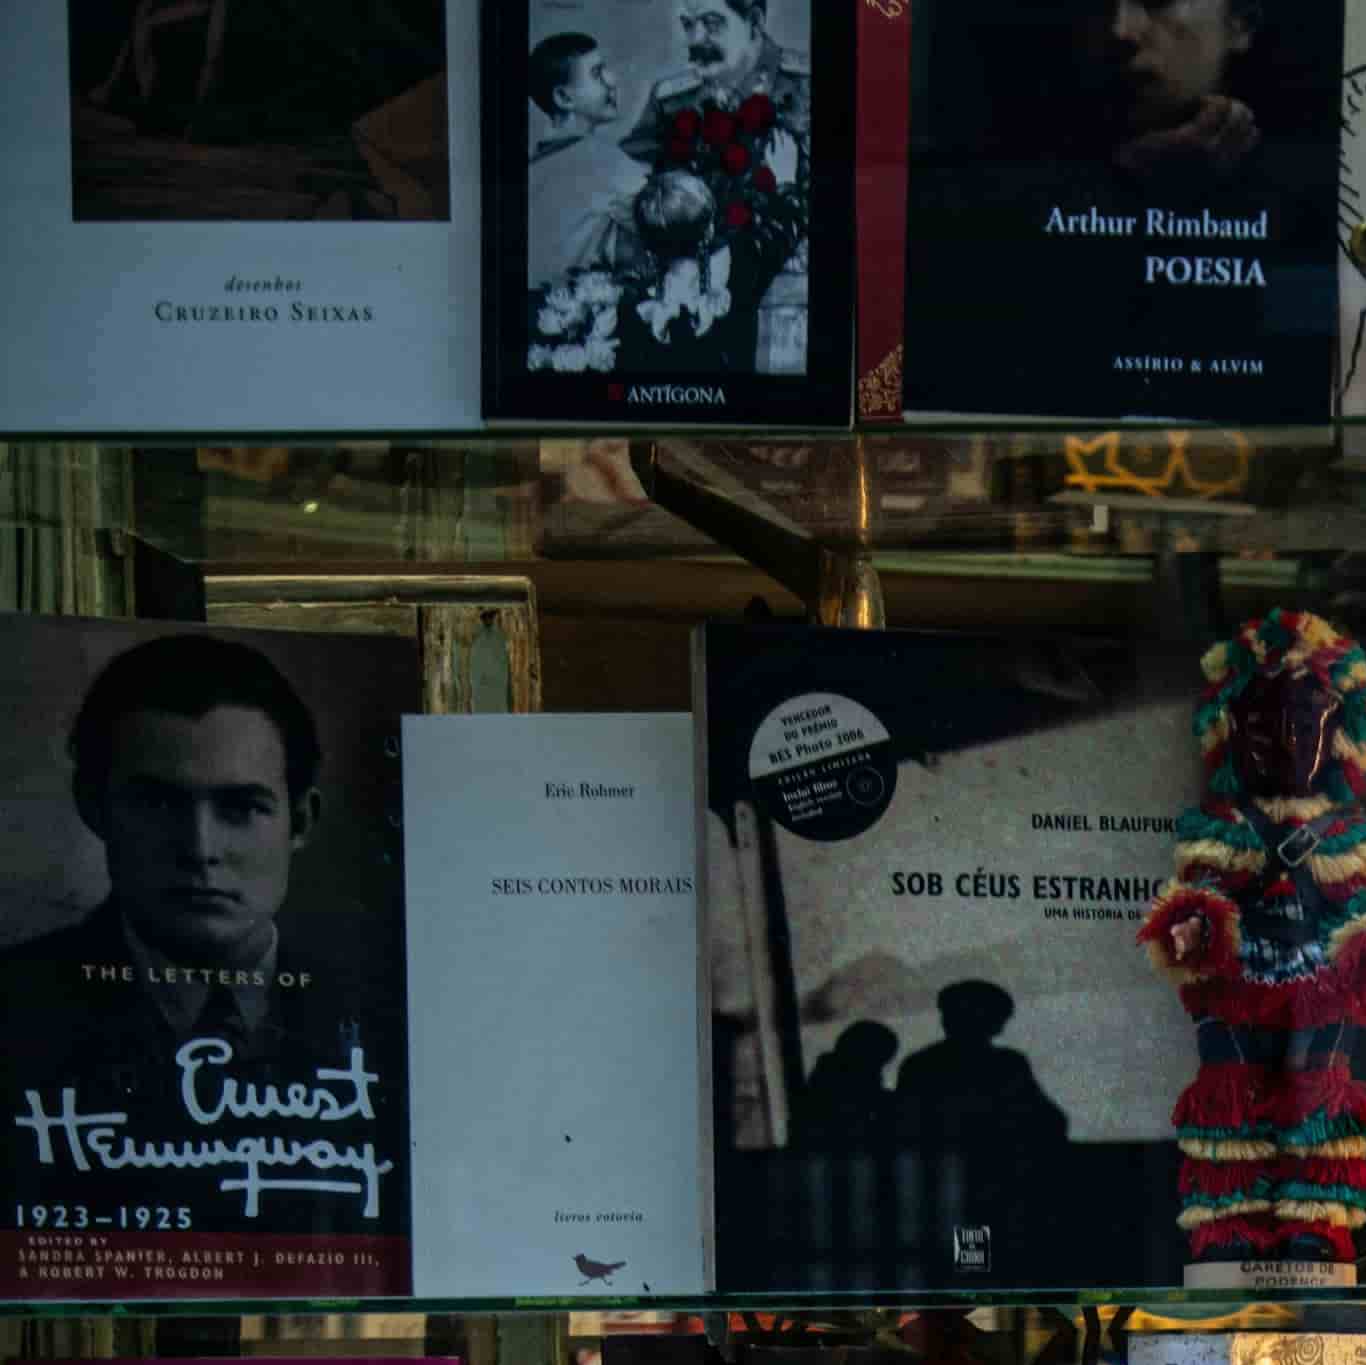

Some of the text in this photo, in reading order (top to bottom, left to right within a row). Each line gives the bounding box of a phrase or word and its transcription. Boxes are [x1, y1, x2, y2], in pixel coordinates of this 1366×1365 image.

[1044, 206, 1269, 241] Arthur Rimbaud
[1144, 257, 1268, 289] POESIA
[153, 301, 374, 323] CRUZEIRO SEIXAS
[627, 384, 726, 405] ANTÍGONA
[544, 782, 636, 801] Eric Rohmer
[490, 876, 695, 897] SEIS CONTOS MORAIS
[889, 871, 944, 898] SOB
[954, 866, 1022, 899] CÉUS
[80, 961, 312, 989] THE LETTERS OF
